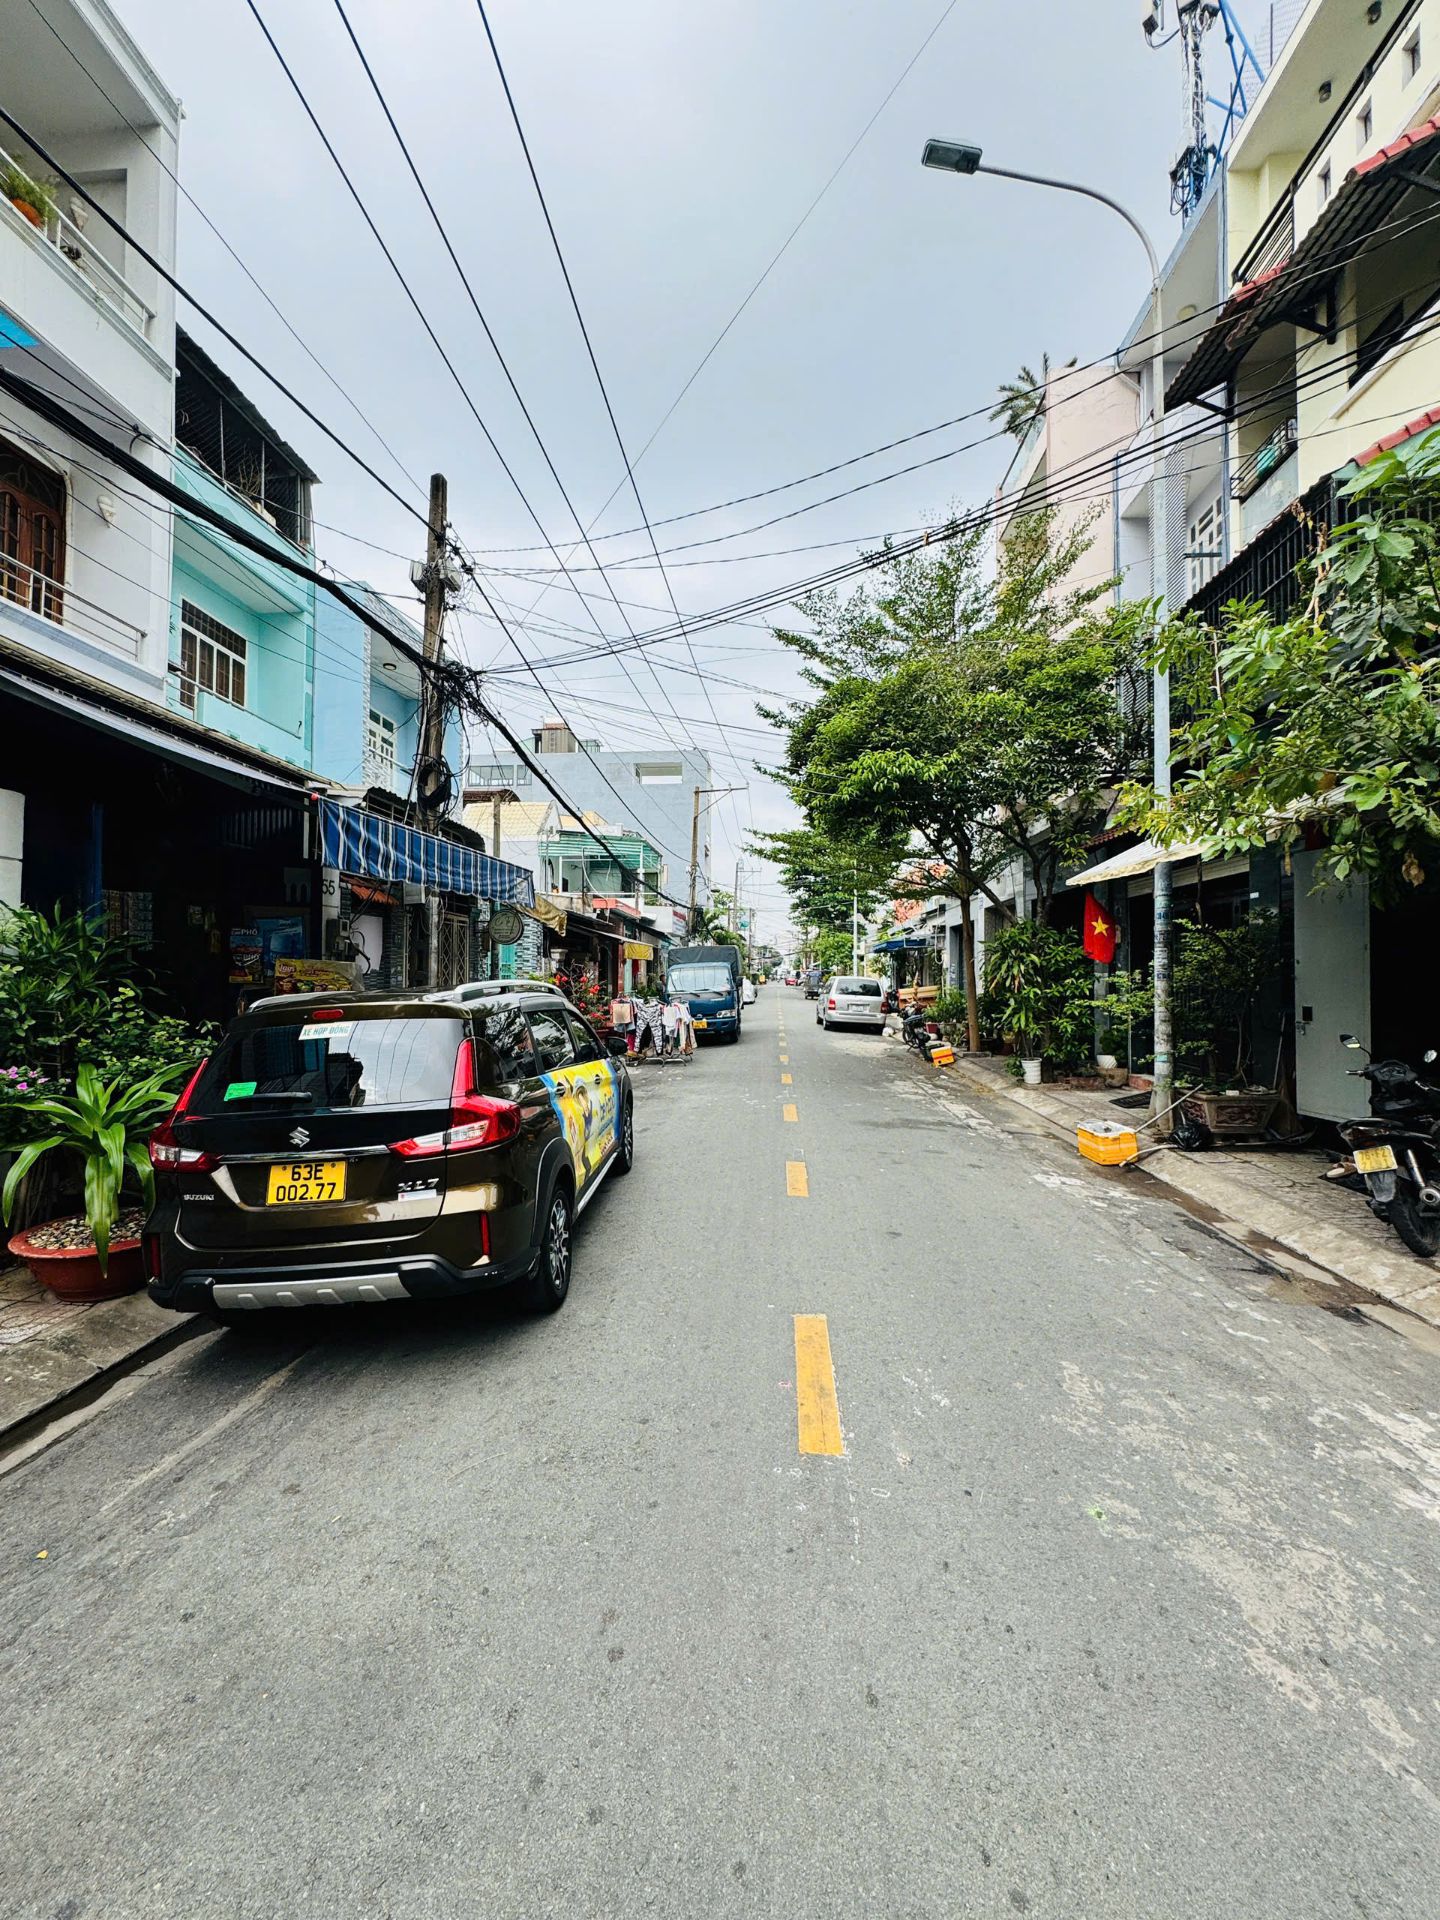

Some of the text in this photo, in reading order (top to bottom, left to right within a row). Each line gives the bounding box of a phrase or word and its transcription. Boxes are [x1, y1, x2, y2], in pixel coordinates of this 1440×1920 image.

[291, 1163, 325, 1181] 63E
[276, 1182, 336, 1202] 002.77
[398, 1177, 440, 1191] XL7
